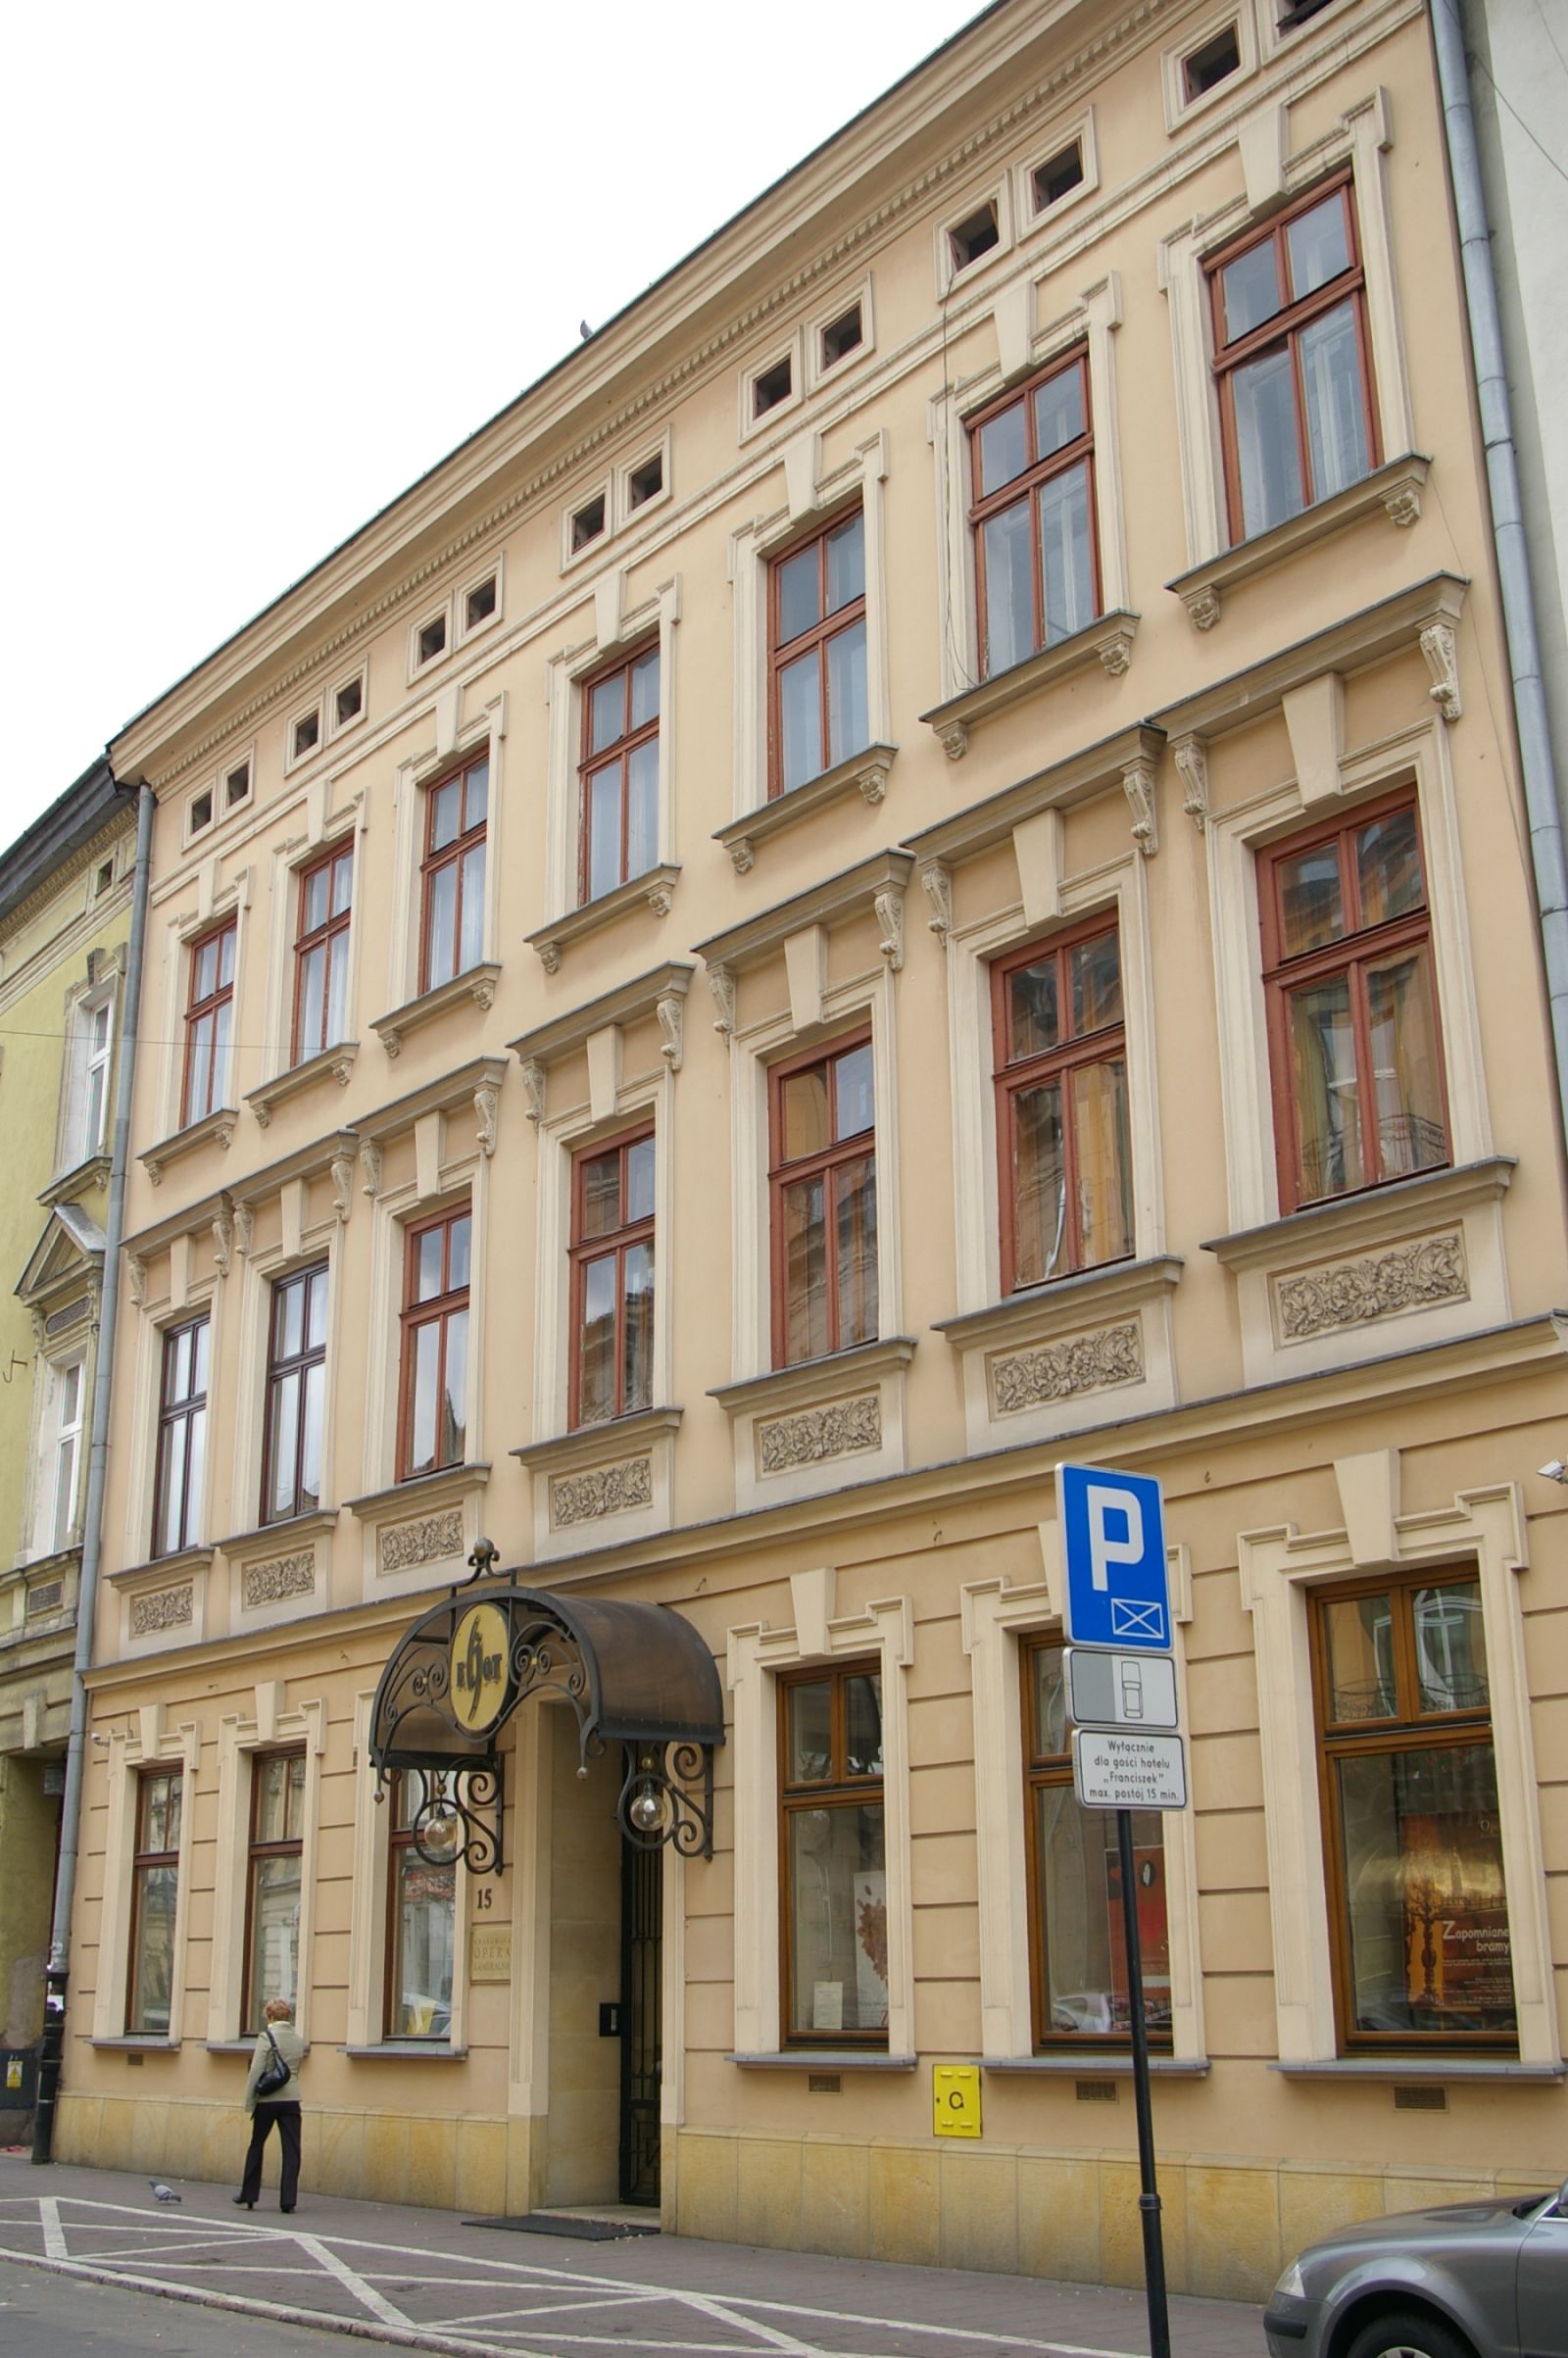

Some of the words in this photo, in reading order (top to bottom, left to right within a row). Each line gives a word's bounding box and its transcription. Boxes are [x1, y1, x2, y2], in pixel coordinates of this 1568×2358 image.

[1087, 1485, 1145, 1592] P
[1107, 1740, 1154, 1754] Wyłącznie
[1094, 1755, 1109, 1766] dla
[1112, 1755, 1137, 1769] gości
[1141, 1757, 1170, 1769] hotelu
[1147, 1788, 1156, 1799] 15
[477, 1888, 493, 1910] 15
[1442, 1920, 1509, 1942] Zapomniane
[474, 1945, 511, 1959] OPERA
[1476, 1940, 1509, 1955] bramy
